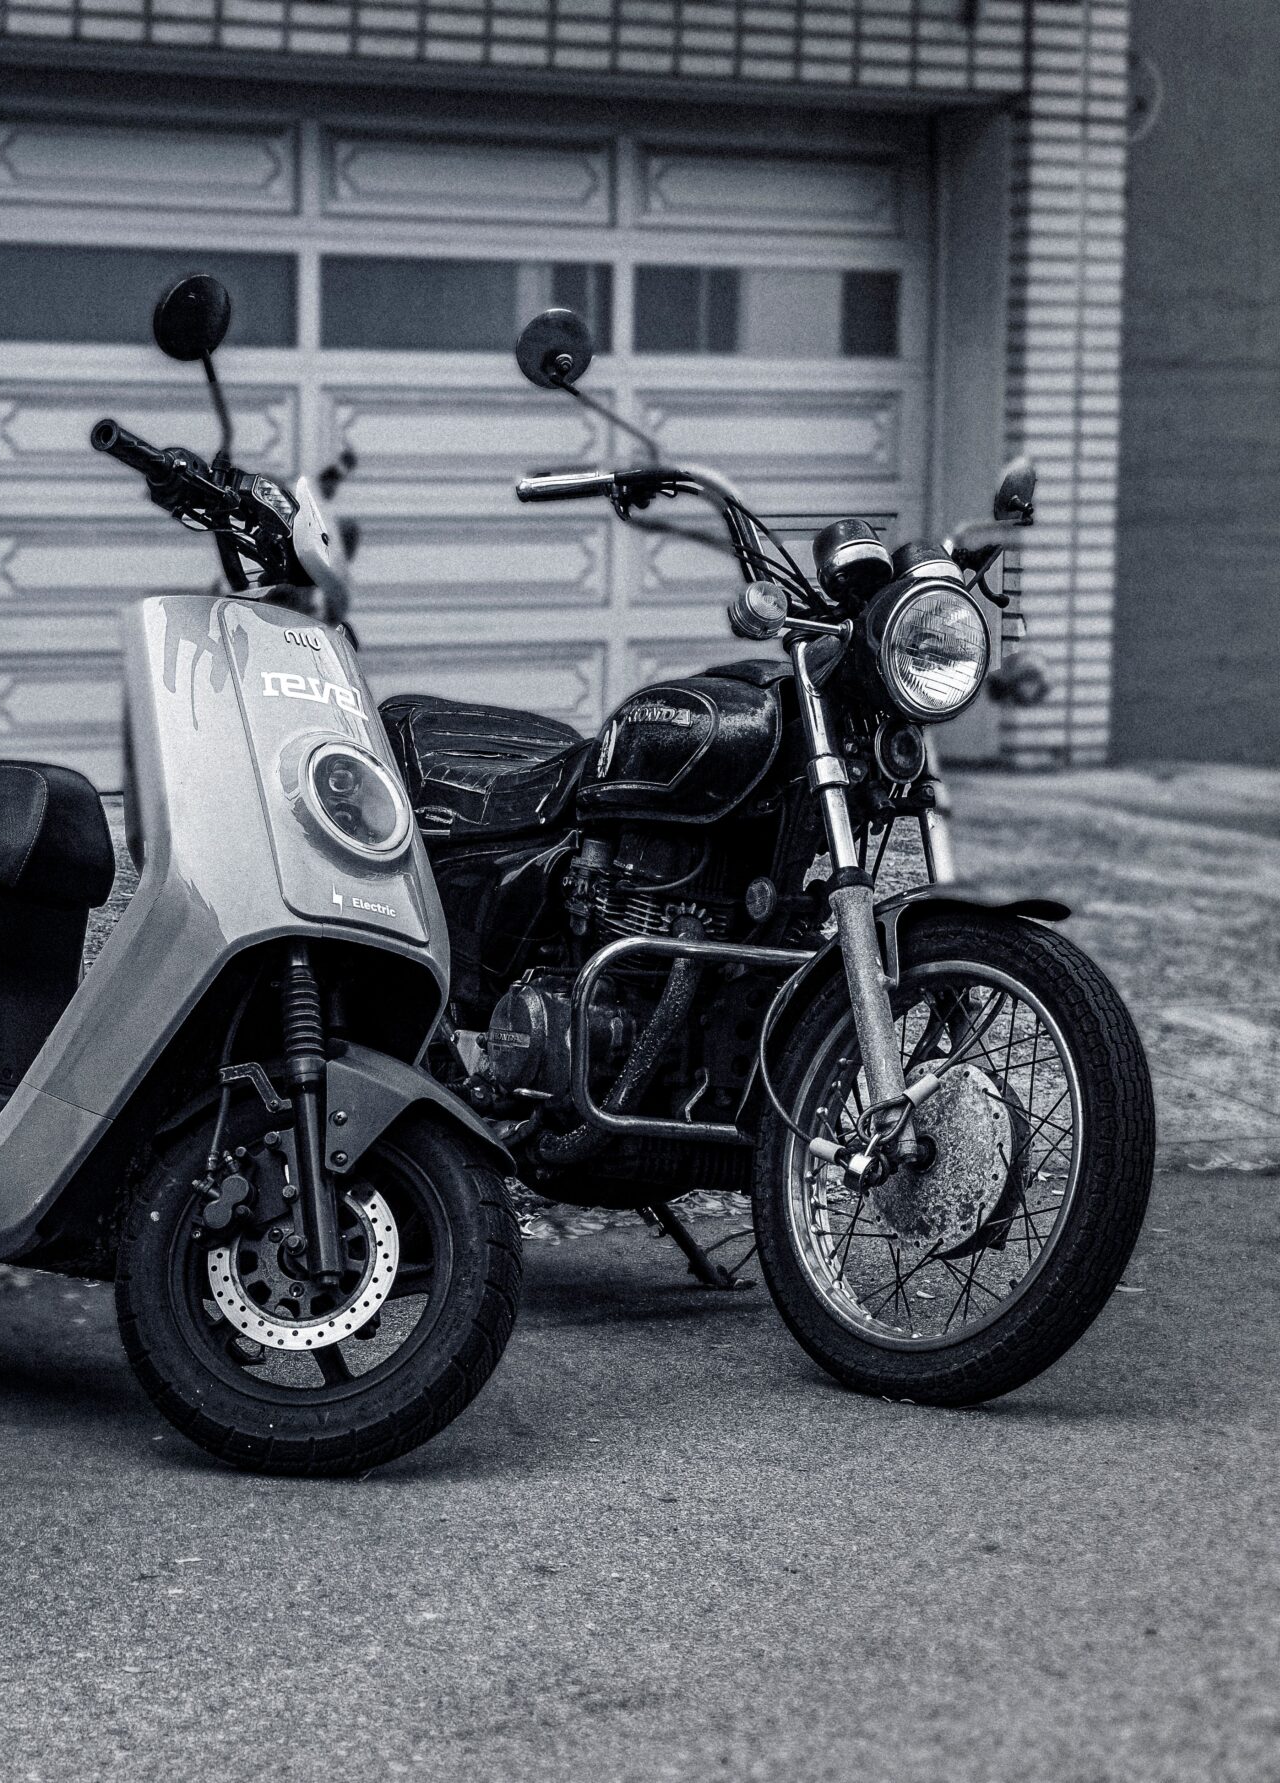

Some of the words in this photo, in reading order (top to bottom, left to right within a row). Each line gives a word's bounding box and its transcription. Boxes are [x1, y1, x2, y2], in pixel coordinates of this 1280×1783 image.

[261, 671, 369, 721] revel
[627, 707, 692, 727] HONDA
[352, 898, 396, 917] Electric
